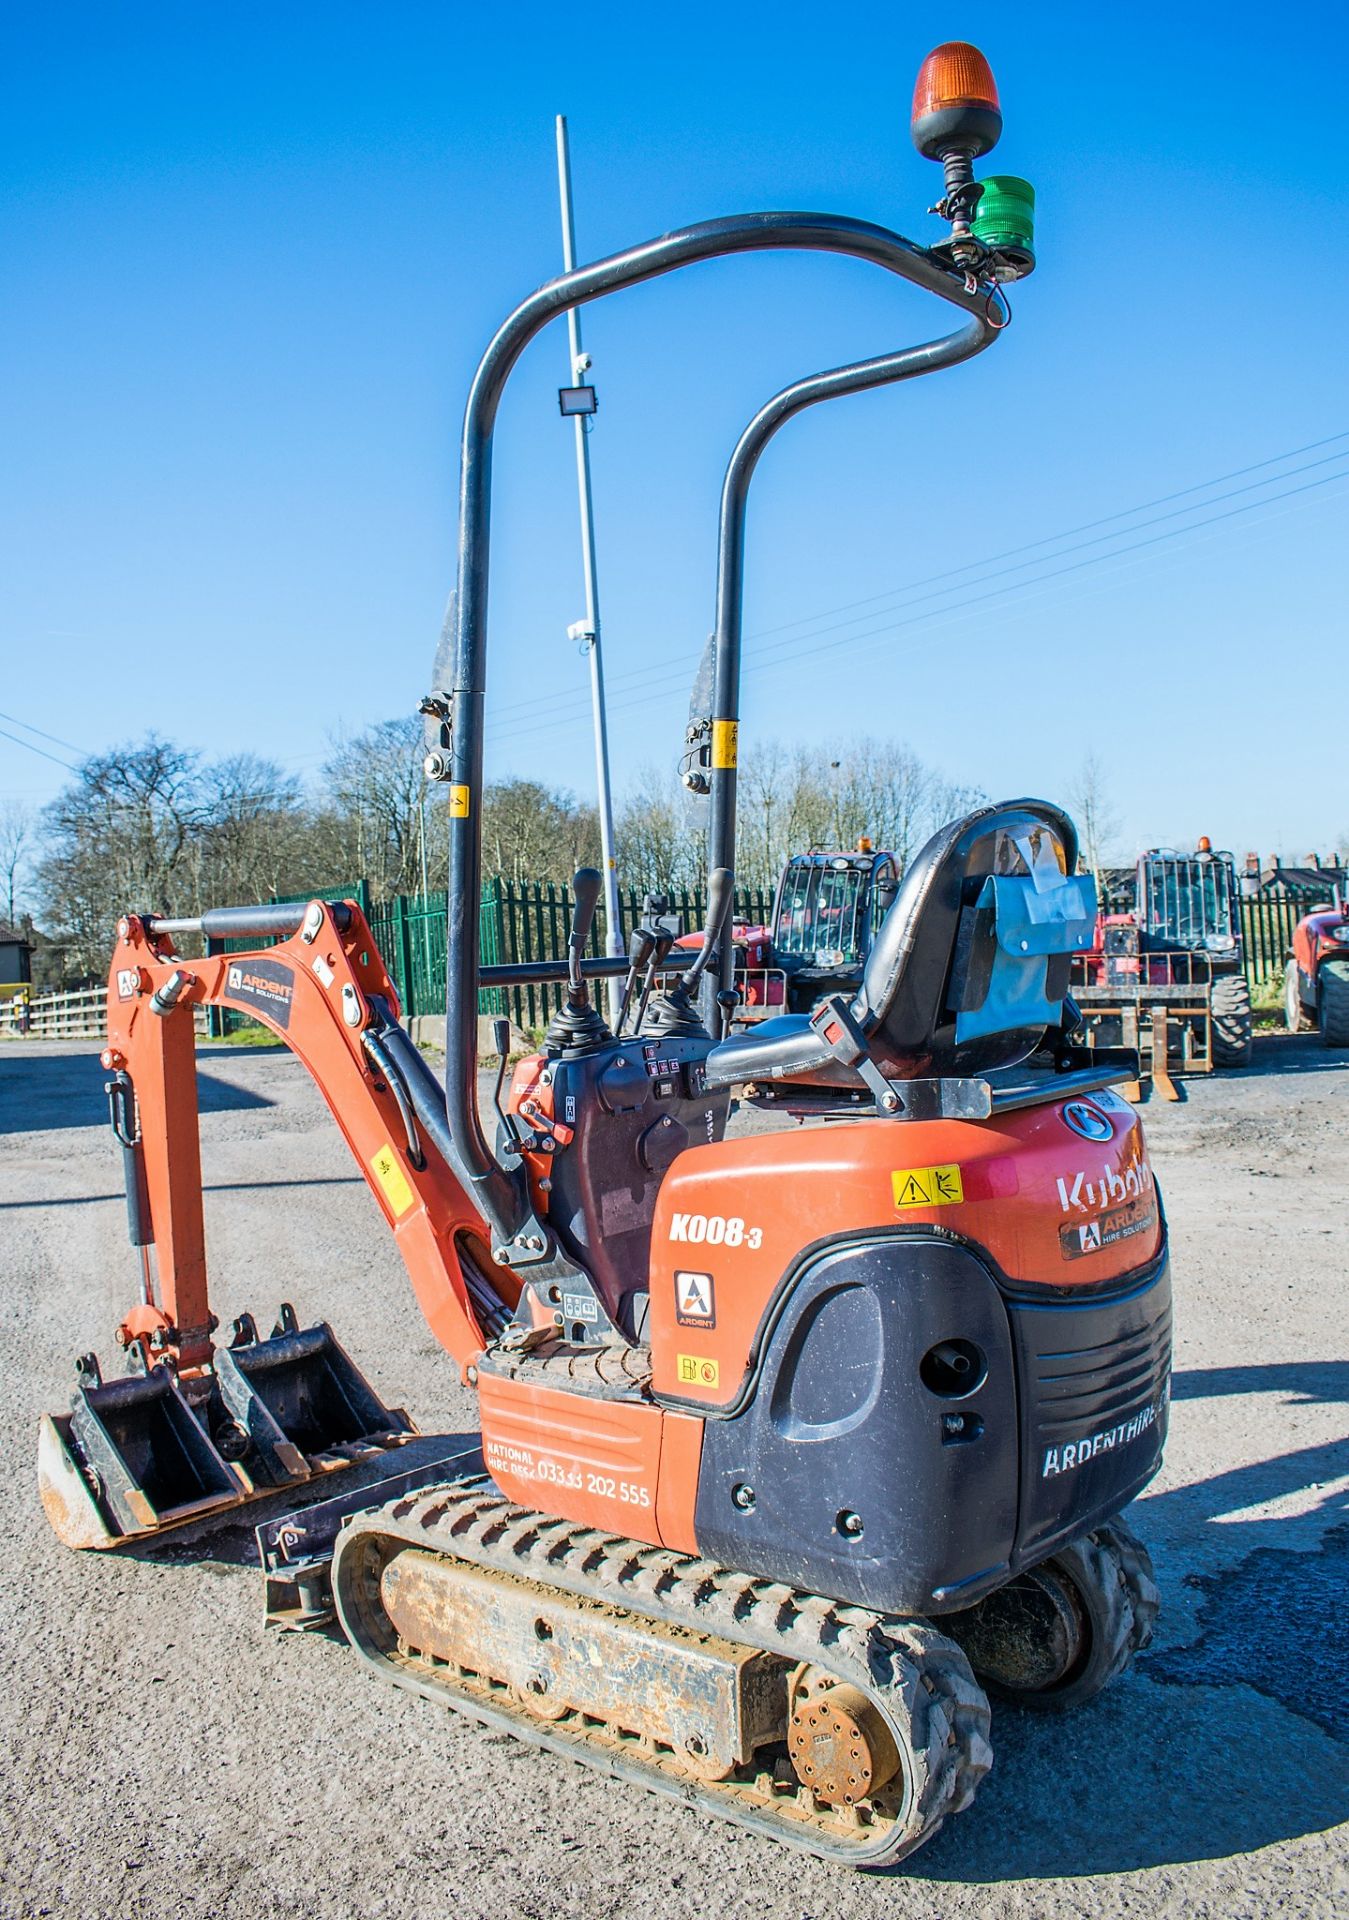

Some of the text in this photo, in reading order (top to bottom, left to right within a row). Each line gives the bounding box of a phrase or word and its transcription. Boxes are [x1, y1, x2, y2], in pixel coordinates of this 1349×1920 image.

[242, 974, 292, 997] ARDENT
[255, 988, 289, 1004] SOLUTIONS
[1056, 1153, 1152, 1212] Kubota
[669, 1213, 763, 1249] K008-3
[1102, 1231, 1120, 1244] HIRE
[679, 1317, 713, 1328] ARDENT
[486, 1442, 534, 1465] NATIONAL
[537, 1460, 650, 1508] 03333 202 555
